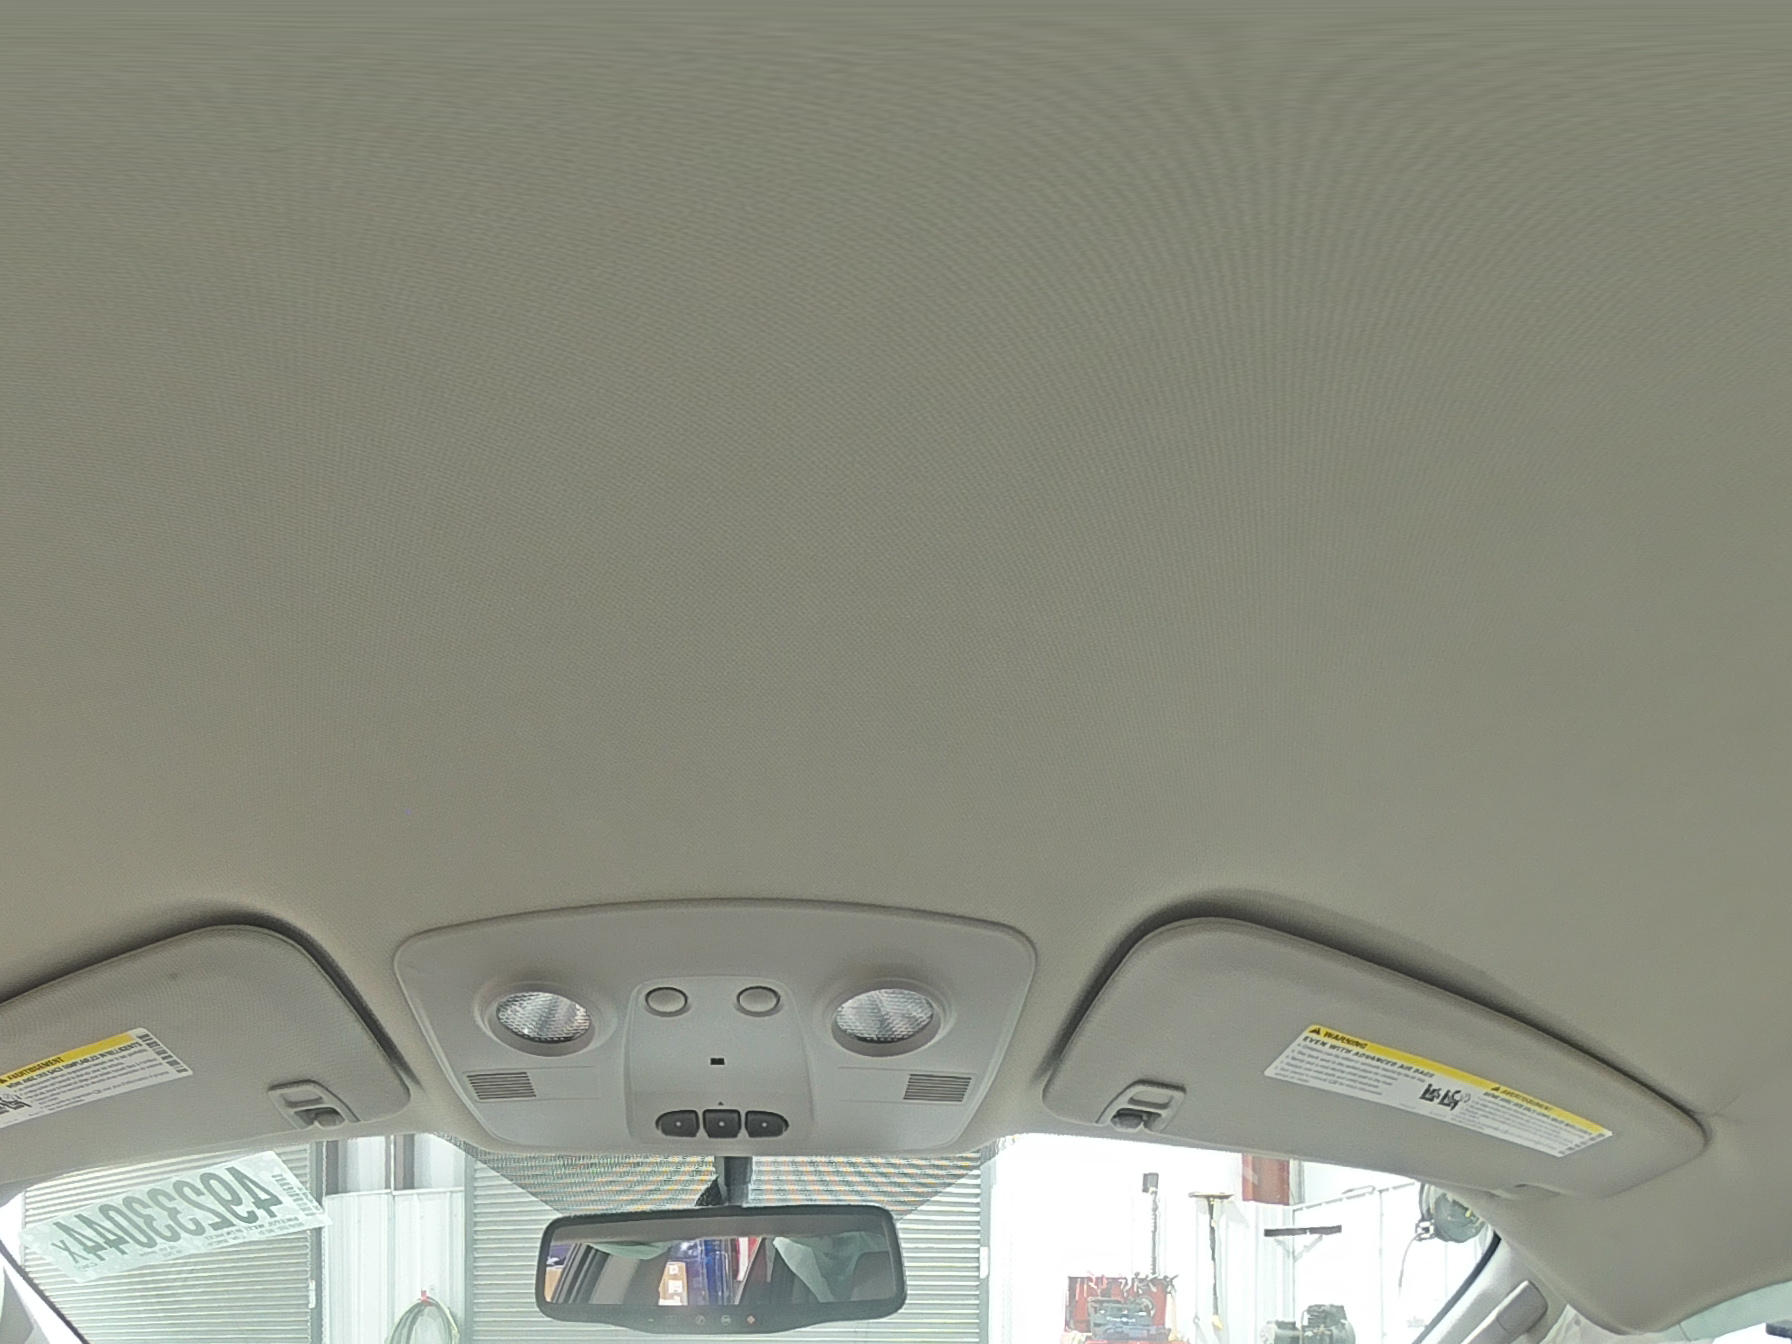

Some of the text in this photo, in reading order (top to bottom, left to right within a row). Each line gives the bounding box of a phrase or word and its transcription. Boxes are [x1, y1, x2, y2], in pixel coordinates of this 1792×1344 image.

[1323, 1031, 1368, 1049] WARNING
[1302, 1036, 1327, 1048] EVEN
[1329, 1043, 1352, 1054] WITH
[1352, 1049, 1398, 1067] ADVANCED
[1397, 1063, 1414, 1073] AIR
